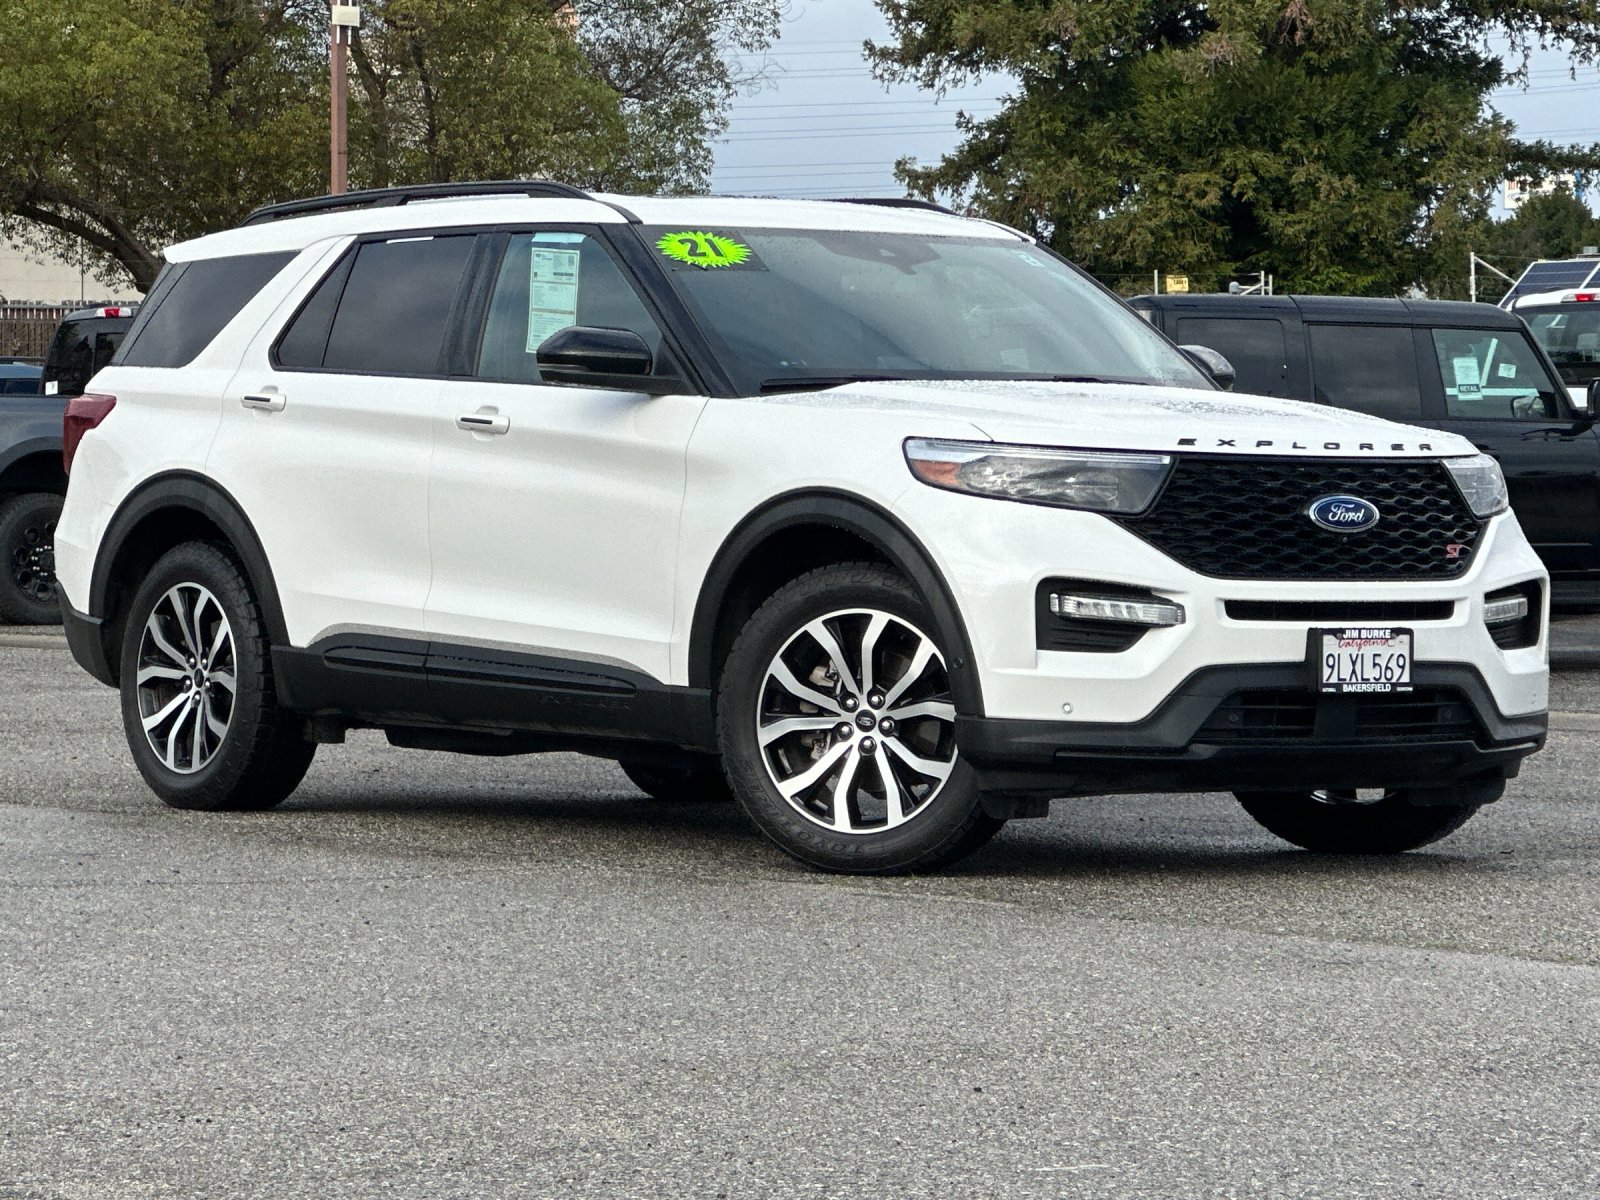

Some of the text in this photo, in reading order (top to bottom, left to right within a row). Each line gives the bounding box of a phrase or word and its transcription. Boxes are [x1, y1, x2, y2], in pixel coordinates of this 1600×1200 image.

[678, 238, 725, 257] 21
[1177, 438, 1432, 451] EXPLORER
[1328, 503, 1365, 523] Ford
[1446, 544, 1462, 558] ST
[1342, 629, 1391, 639] JIM BURKE
[1337, 639, 1395, 652] California
[1325, 653, 1406, 682] 9LXL569
[1342, 684, 1391, 692] BAKERSFIELD
